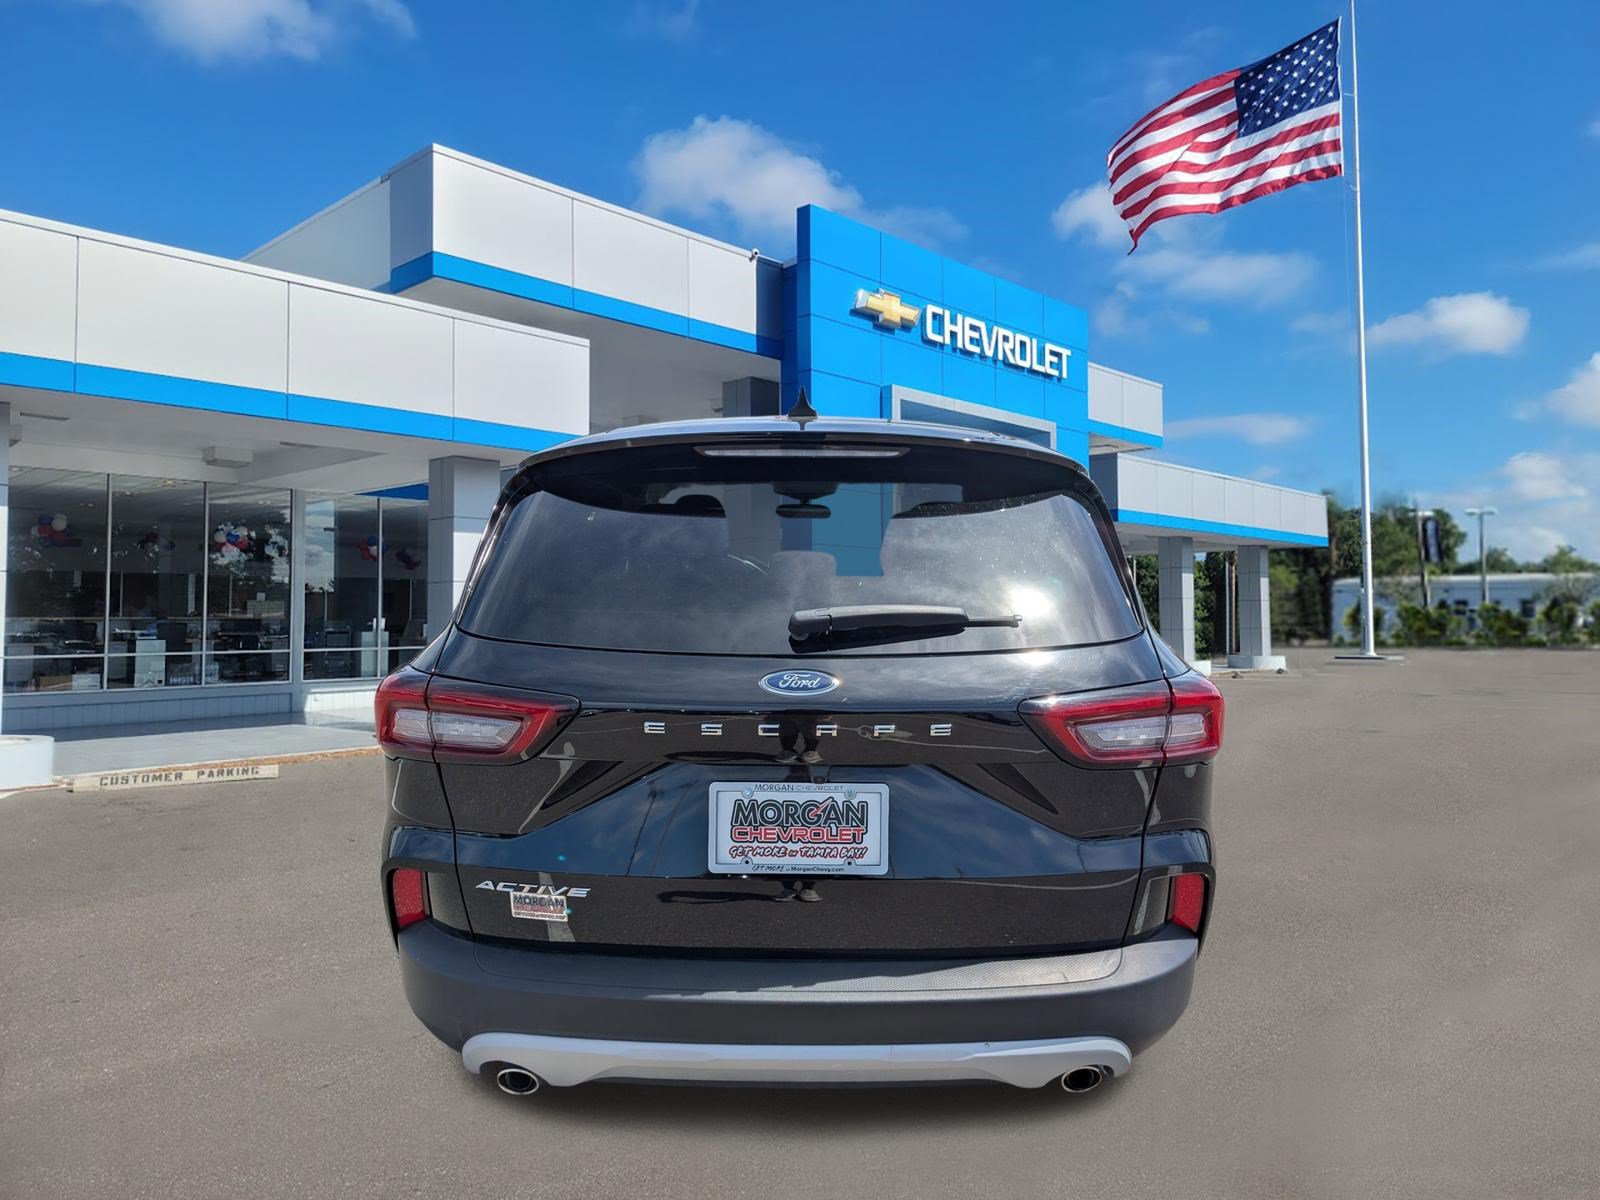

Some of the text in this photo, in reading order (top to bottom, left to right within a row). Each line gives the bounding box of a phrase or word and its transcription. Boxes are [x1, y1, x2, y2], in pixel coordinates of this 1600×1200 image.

[926, 303, 1072, 379] CHEVROLET
[778, 672, 821, 689] Ford
[643, 721, 952, 737] ESCAPE
[99, 766, 260, 787] CUSTOMER PARKING
[754, 783, 794, 792] MORGAN
[731, 798, 869, 828] MORGAN
[731, 826, 867, 844] CHEVROLET
[729, 846, 752, 858] GET
[752, 846, 787, 858] MORE
[799, 846, 838, 859] TAMPA
[839, 847, 868, 860] BAY!
[475, 880, 592, 898] ACTIVE
[512, 893, 565, 907] MORGAN
